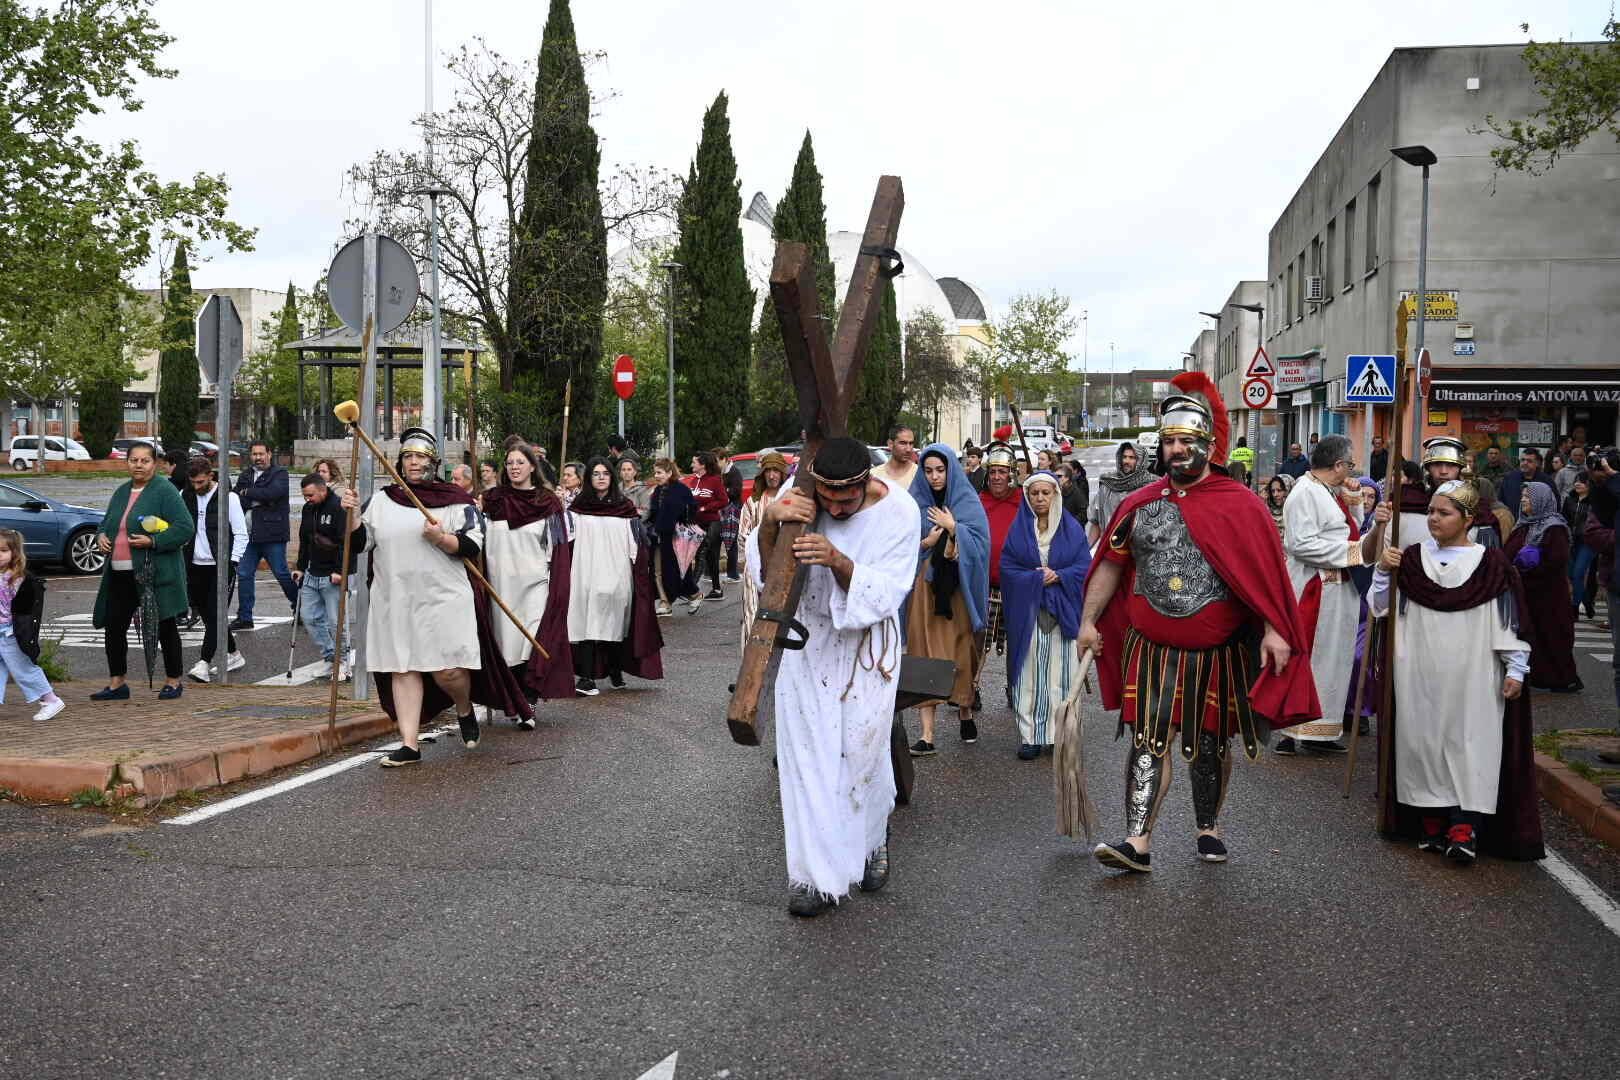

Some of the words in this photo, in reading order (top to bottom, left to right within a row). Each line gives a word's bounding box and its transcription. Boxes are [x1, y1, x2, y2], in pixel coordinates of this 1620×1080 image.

[1249, 386, 1265, 398] 20
[1435, 389, 1523, 401] Ultramarinos
[1527, 390, 1589, 401] ANTONIA
